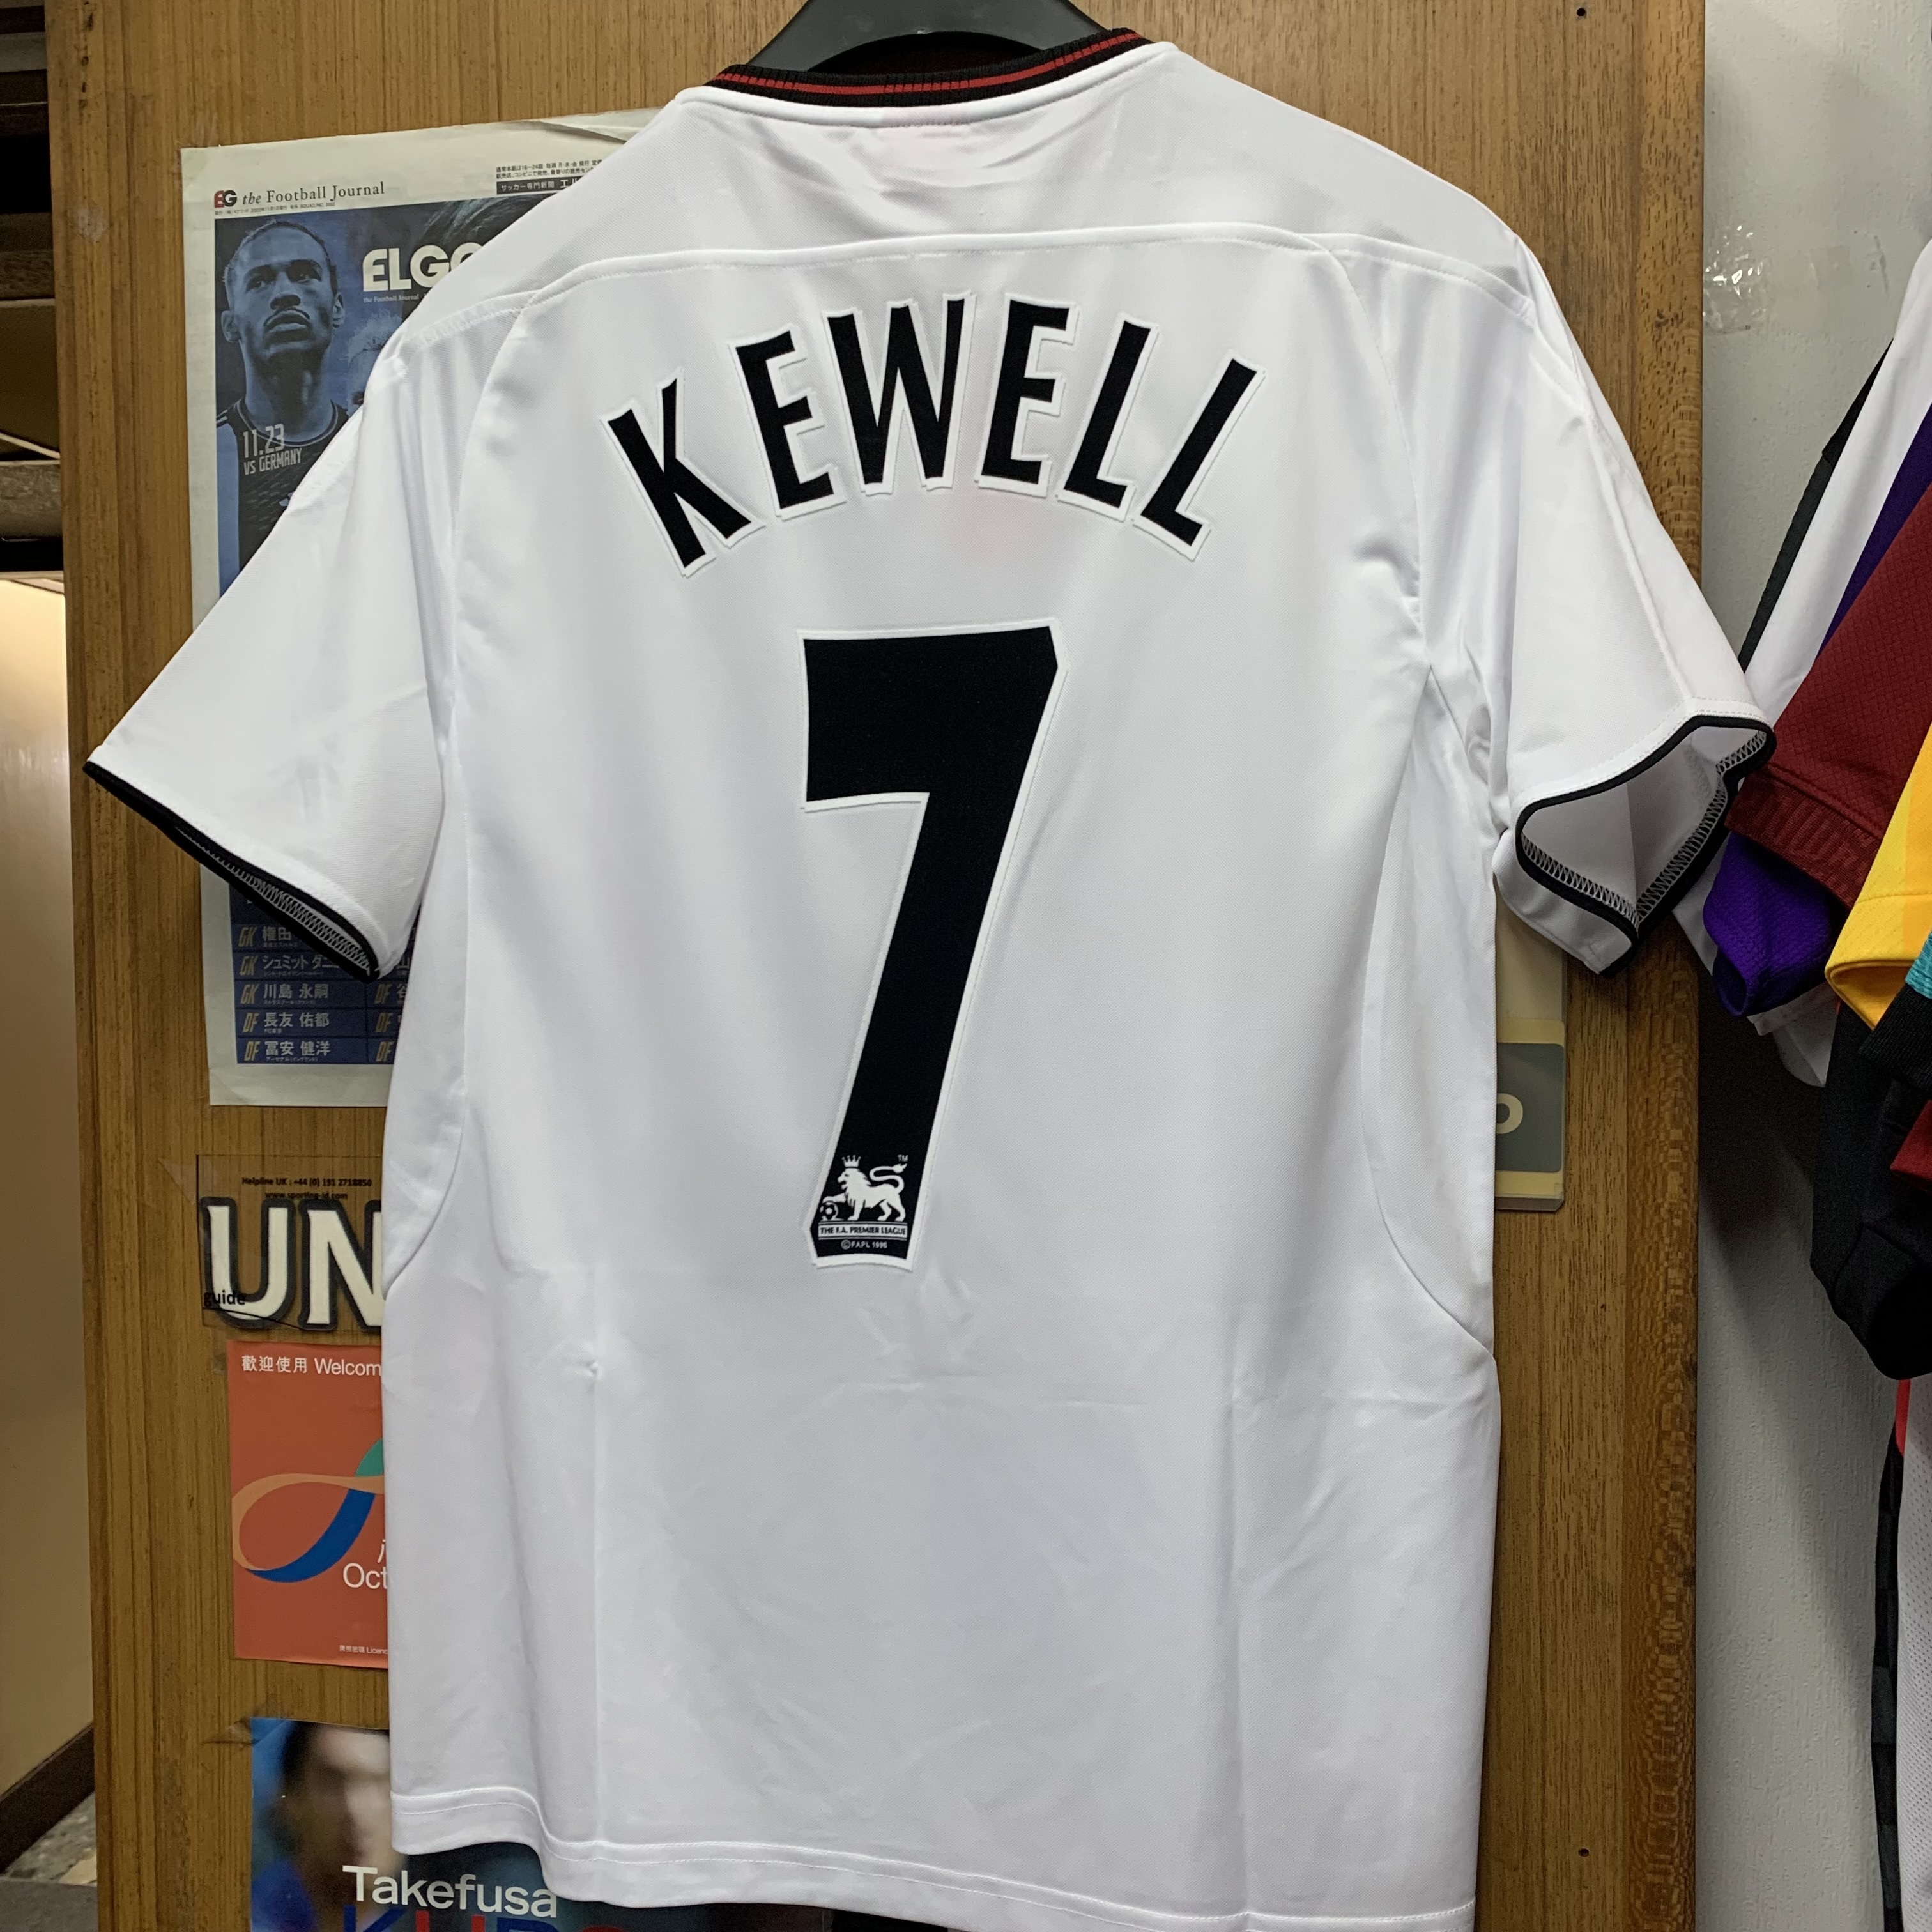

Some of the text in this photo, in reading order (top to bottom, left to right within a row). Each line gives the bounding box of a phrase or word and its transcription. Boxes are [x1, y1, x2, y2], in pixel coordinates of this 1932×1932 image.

[242, 192, 261, 205] the
[266, 186, 326, 203] Football
[330, 181, 385, 201] Journal
[243, 423, 284, 458] 11.23
[603, 294, 1262, 573] KEWELL
[243, 447, 302, 475] VS GERMANY
[238, 926, 257, 947] GK
[799, 620, 1064, 1268] 7
[240, 955, 258, 976] GK
[262, 955, 309, 970] シュミット
[240, 983, 329, 1005] GK 川島 永嗣
[374, 983, 393, 1004] DF
[242, 1012, 330, 1033] DF 長友 佑都
[376, 1012, 393, 1033] DF
[244, 1041, 261, 1062] DF
[300, 1041, 331, 1057] 健洋
[376, 1041, 394, 1062] DF
[241, 1177, 273, 1186] Helpline
[276, 1177, 288, 1186] UK
[309, 1177, 319, 1186] (0)
[322, 1178, 335, 1186] 191
[820, 1226, 906, 1235] THE F.A. PREMIER LEAGUE
[204, 1290, 246, 1307] guide
[241, 1355, 381, 1376] 歡迎使用 Welcom
[343, 1563, 388, 1590] Oct
[342, 1865, 557, 1919] Takefusa
